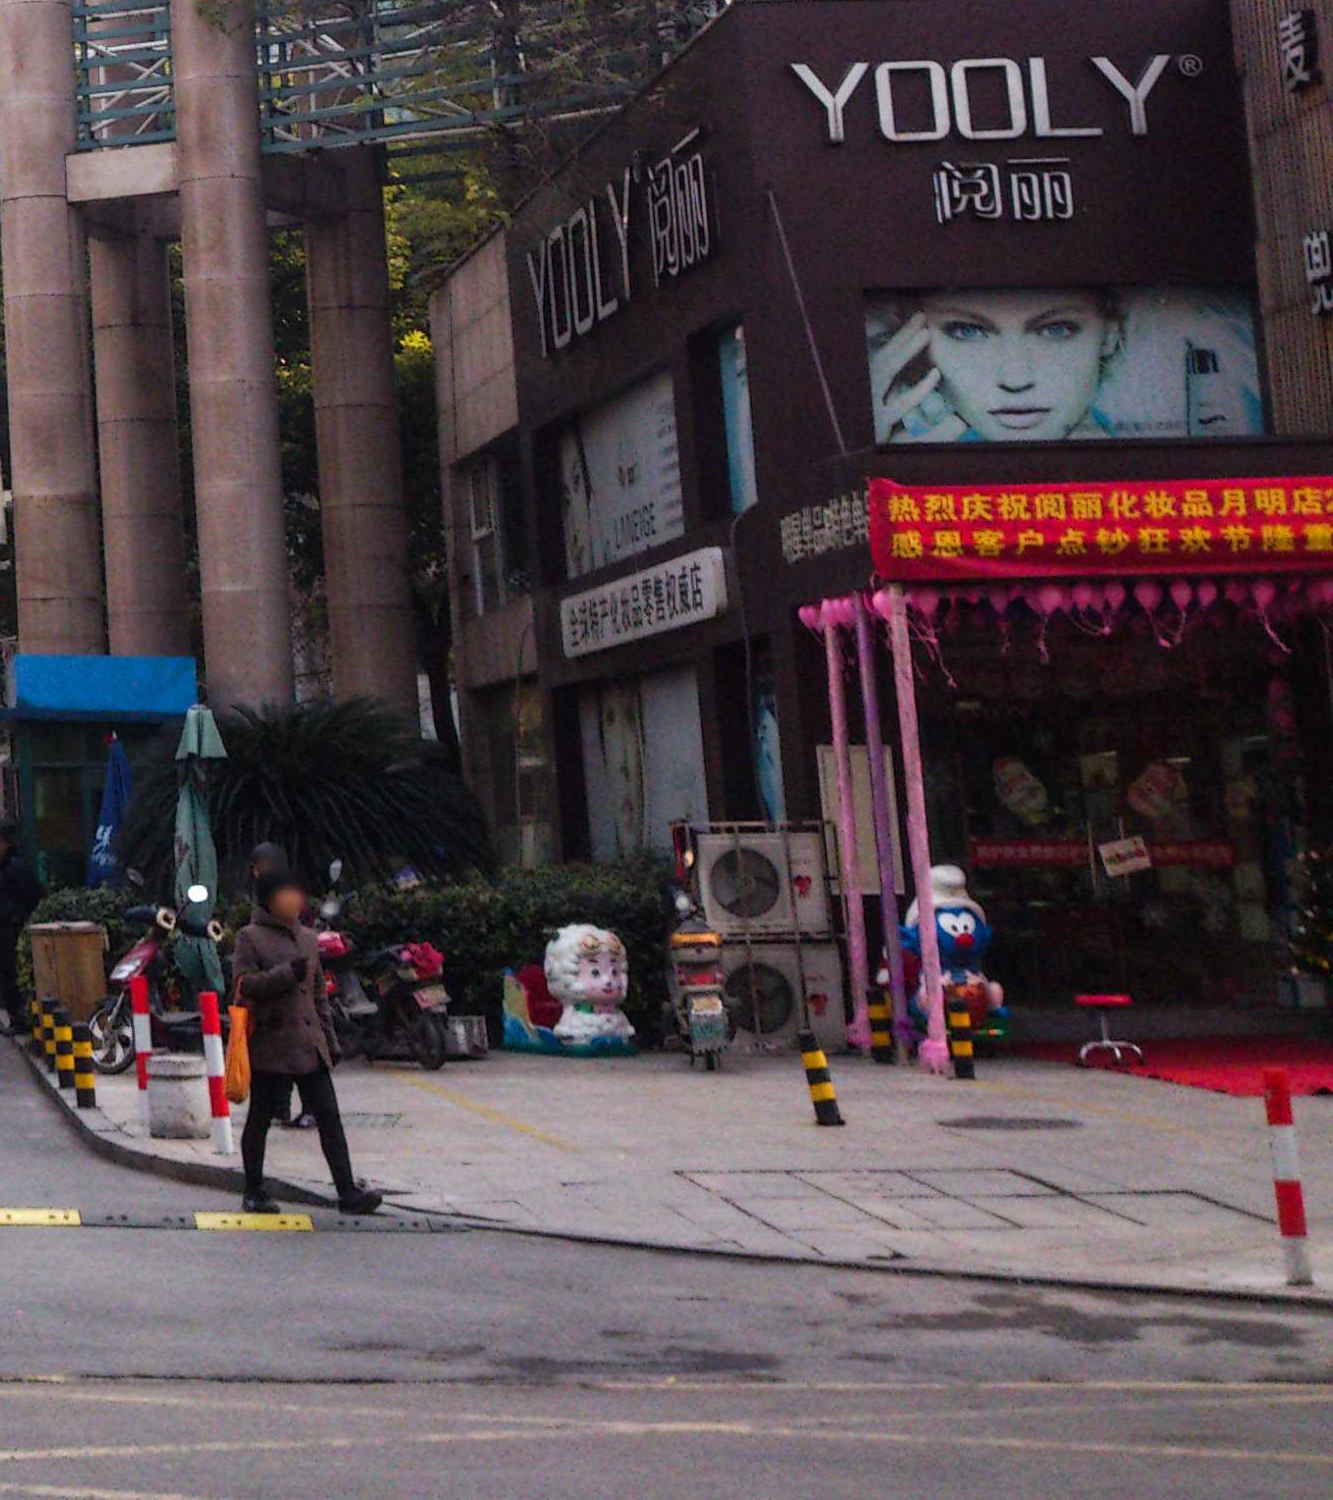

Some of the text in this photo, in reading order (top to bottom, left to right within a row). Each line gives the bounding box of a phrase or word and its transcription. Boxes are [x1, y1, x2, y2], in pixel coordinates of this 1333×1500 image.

[790, 55, 1171, 143] YOOLY
[934, 157, 1074, 223] 阅丽
[526, 128, 709, 360] YOOLY 阅丽
